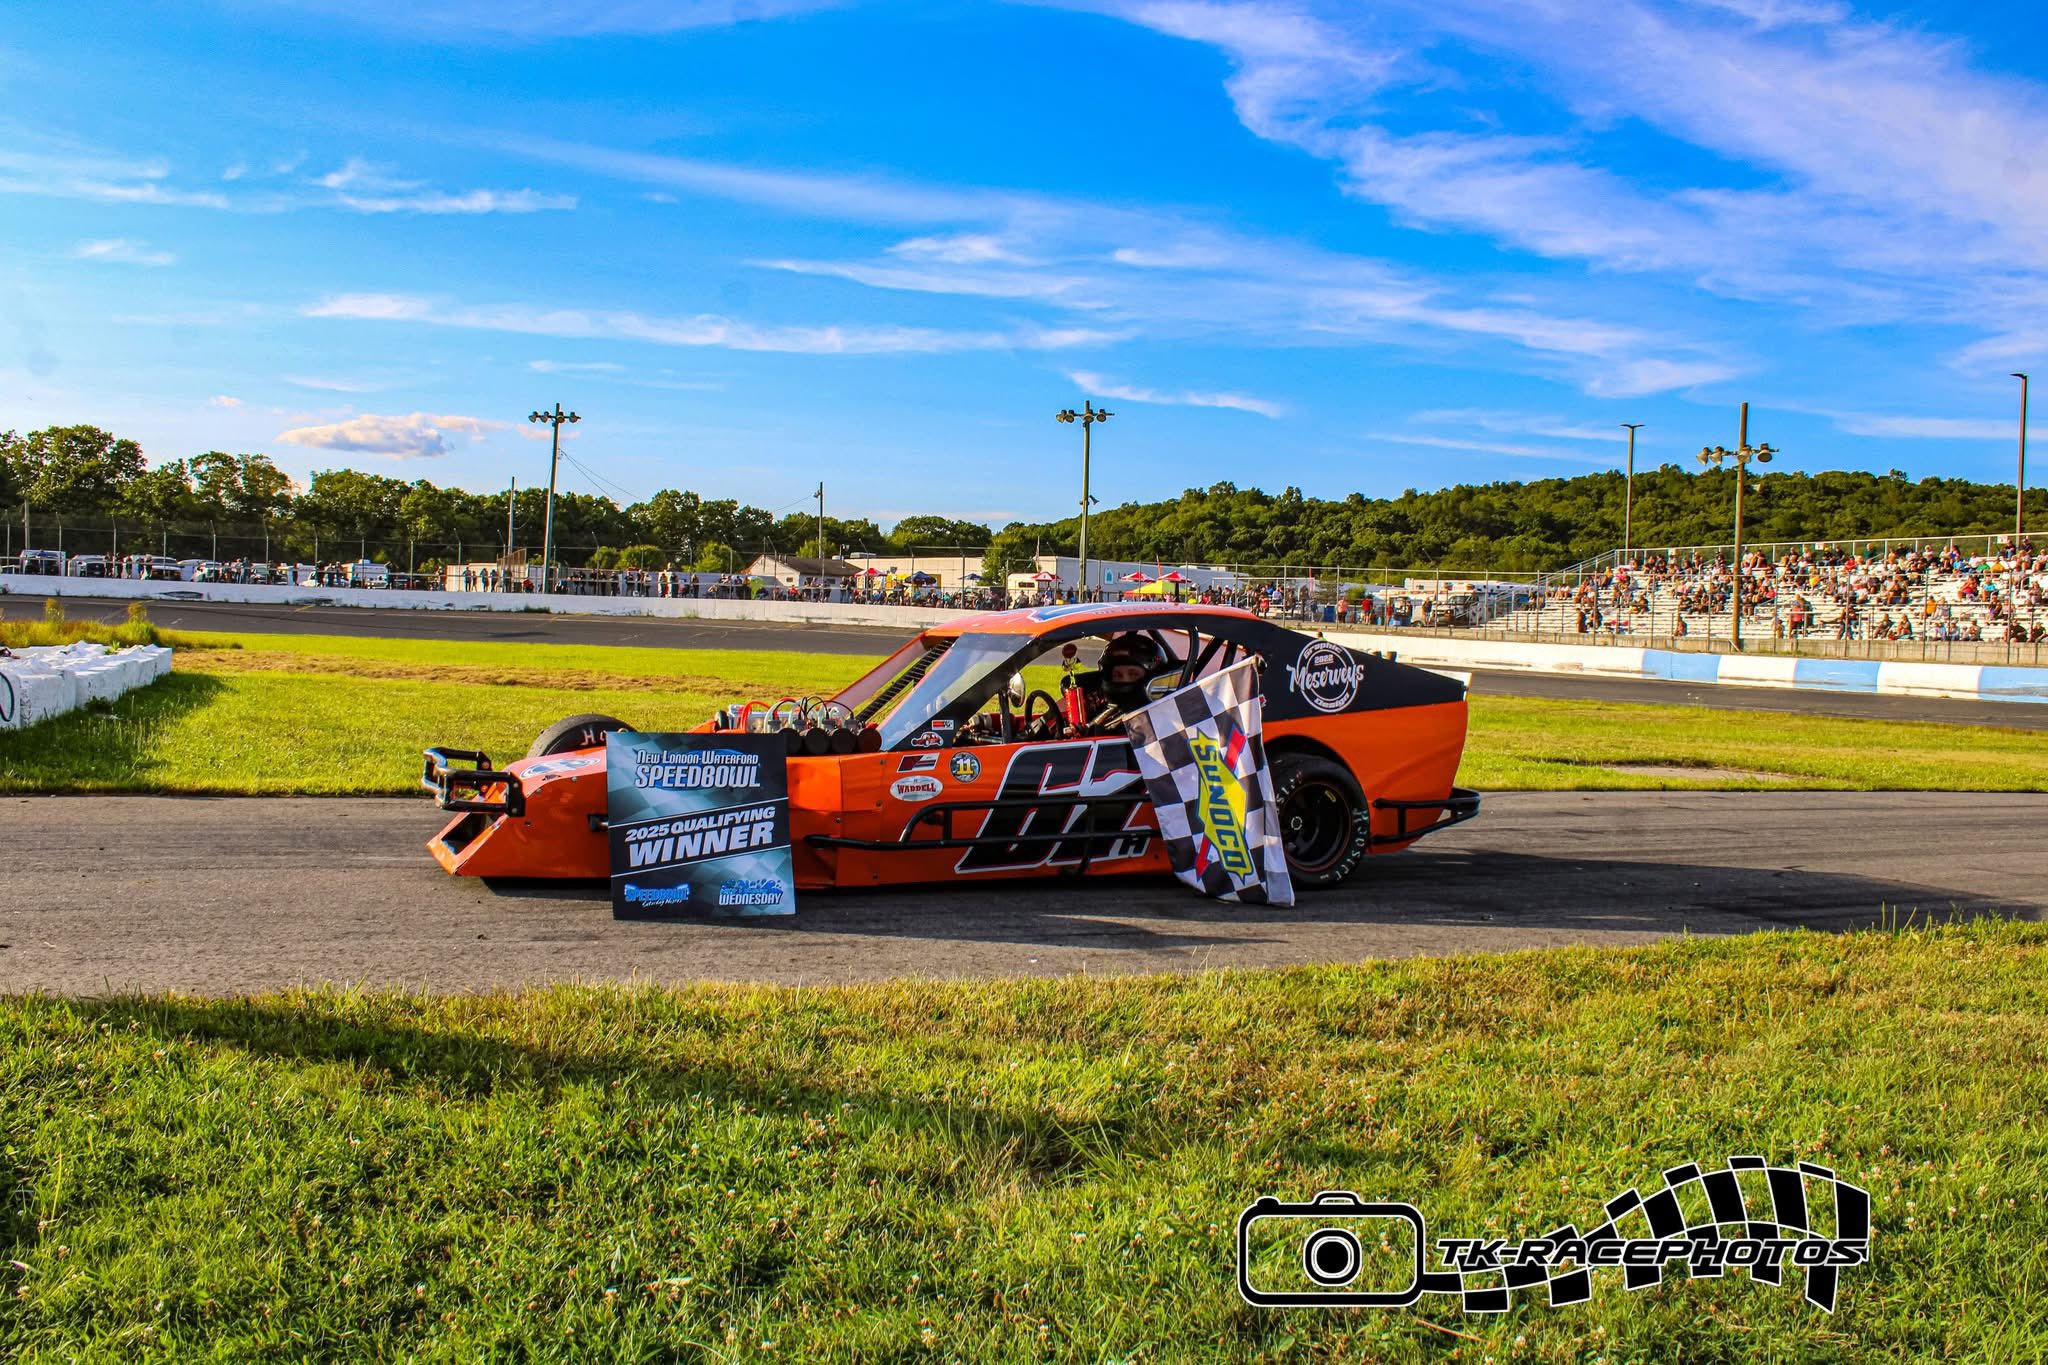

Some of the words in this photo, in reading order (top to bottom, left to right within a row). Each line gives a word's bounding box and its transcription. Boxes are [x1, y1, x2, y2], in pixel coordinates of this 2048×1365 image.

[1286, 664, 1365, 693] Meserveys
[634, 764, 761, 788] SPEEDBOWL
[897, 782, 937, 795] WADDELL
[1194, 744, 1248, 869] SUNOCO
[625, 823, 670, 842] 2025
[670, 806, 777, 834] QUALIFYING
[629, 821, 775, 868] WINNER
[719, 892, 782, 906] WEDNESDAY
